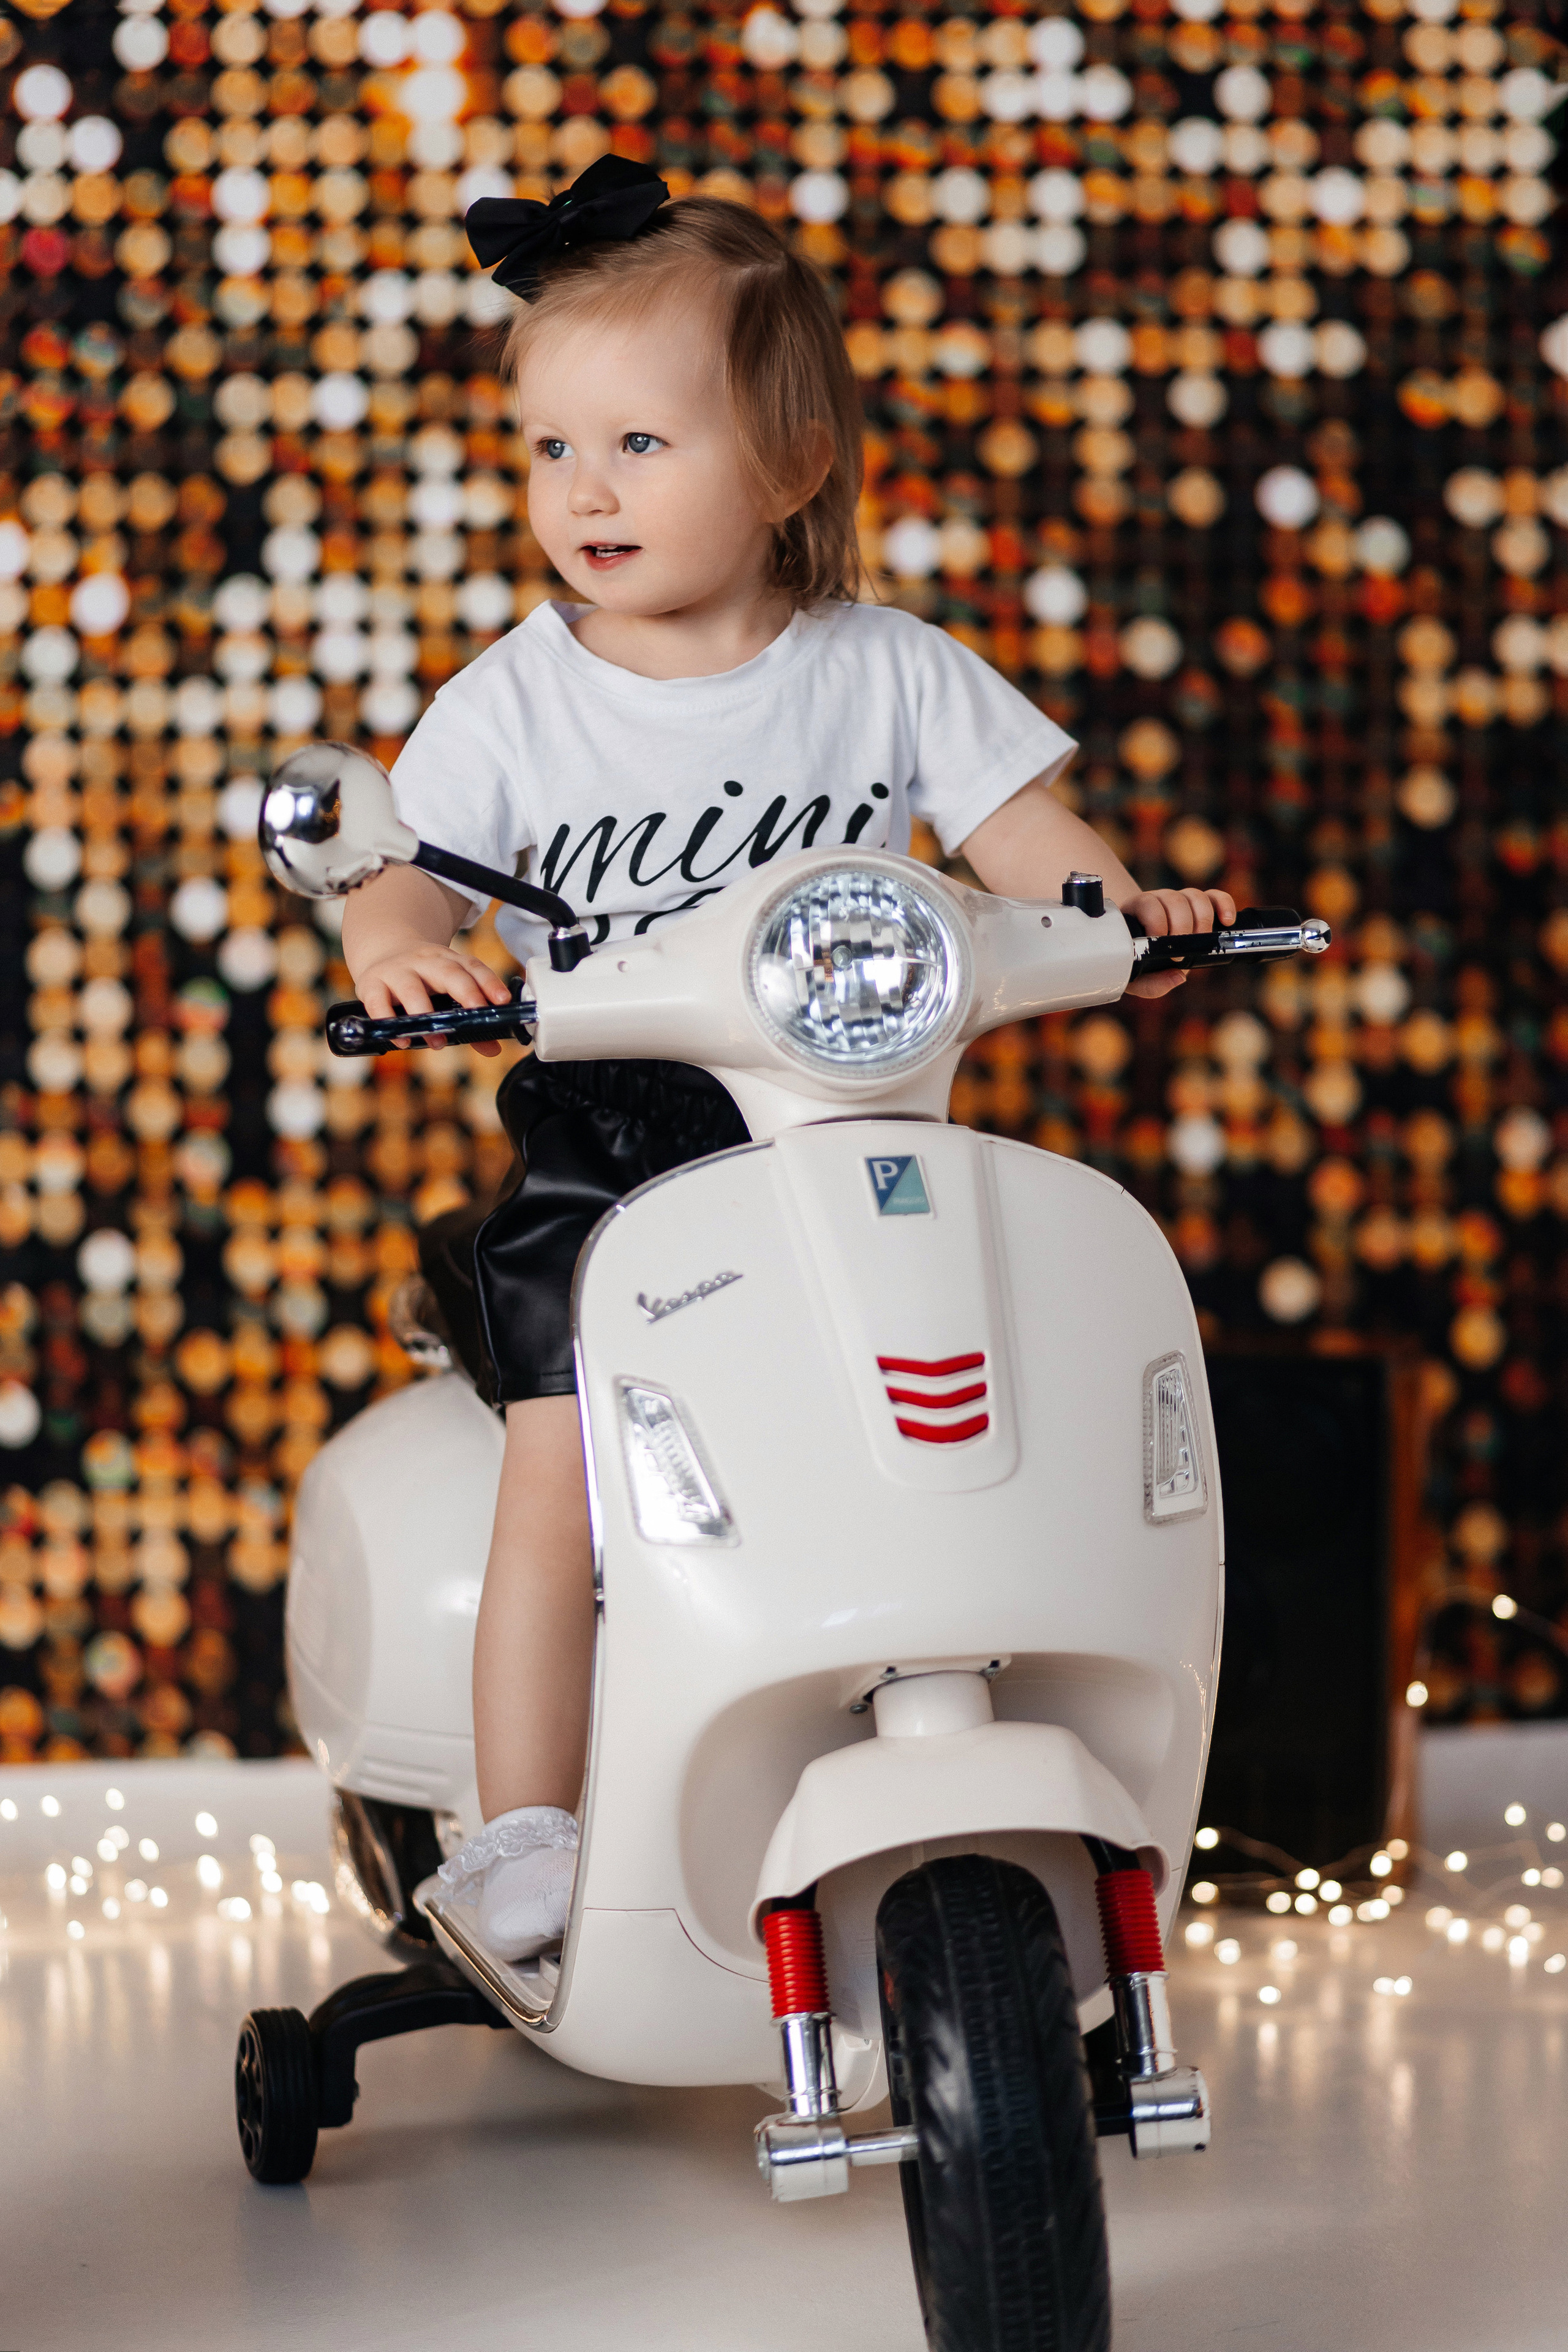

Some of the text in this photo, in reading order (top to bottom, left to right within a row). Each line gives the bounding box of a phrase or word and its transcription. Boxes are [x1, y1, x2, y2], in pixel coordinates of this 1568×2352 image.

[540, 780, 889, 903] mini
[871, 1160, 899, 1189] P
[637, 1271, 743, 1324] Vespa
